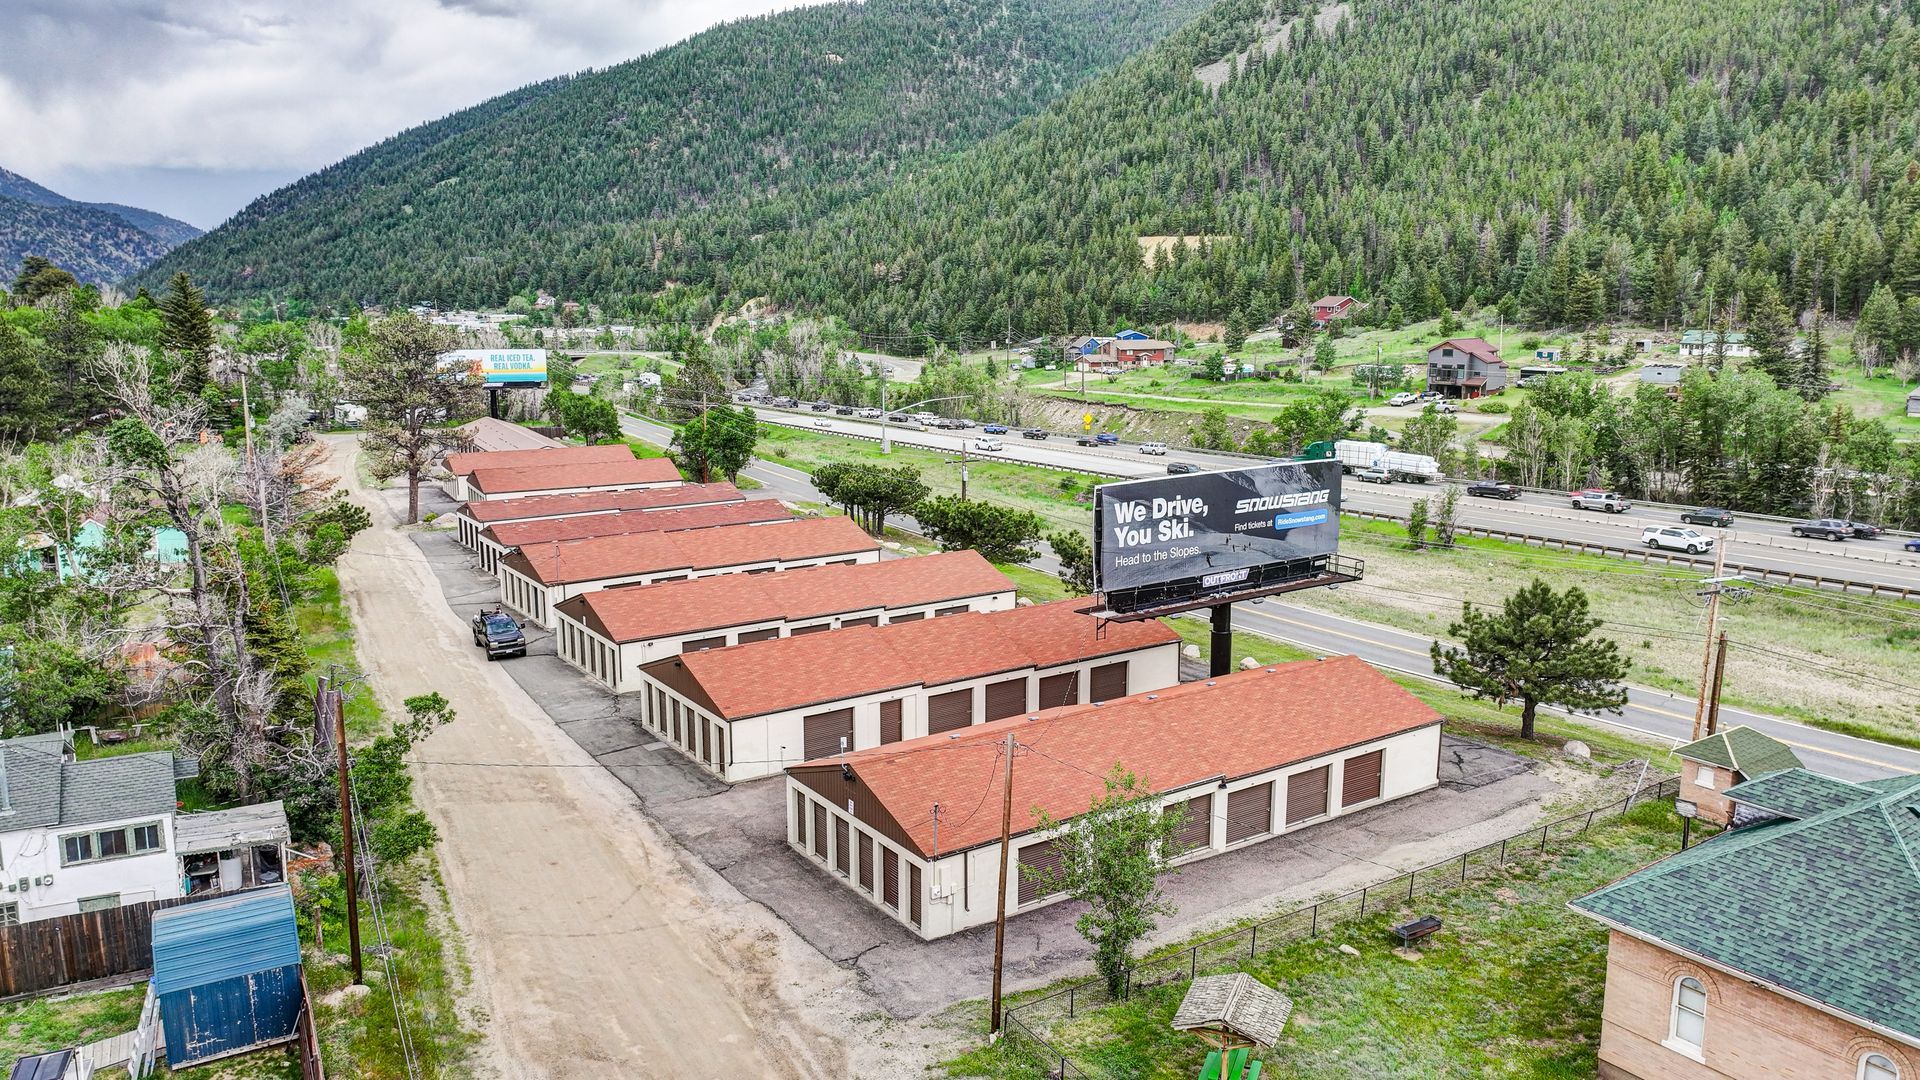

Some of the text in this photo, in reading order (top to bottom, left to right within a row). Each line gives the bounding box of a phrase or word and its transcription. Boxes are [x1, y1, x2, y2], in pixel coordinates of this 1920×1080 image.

[490, 354, 505, 362] REAL
[493, 362, 509, 370] REAL
[1113, 494, 1209, 525] We Drive,
[1113, 517, 1195, 548] You Ski.
[1234, 522, 1248, 532] Find
[1248, 520, 1267, 530] tickets
[1266, 519, 1273, 528] at
[1115, 546, 1202, 568] Head to the Slopes.
[1204, 570, 1248, 586] OUTFRONT
